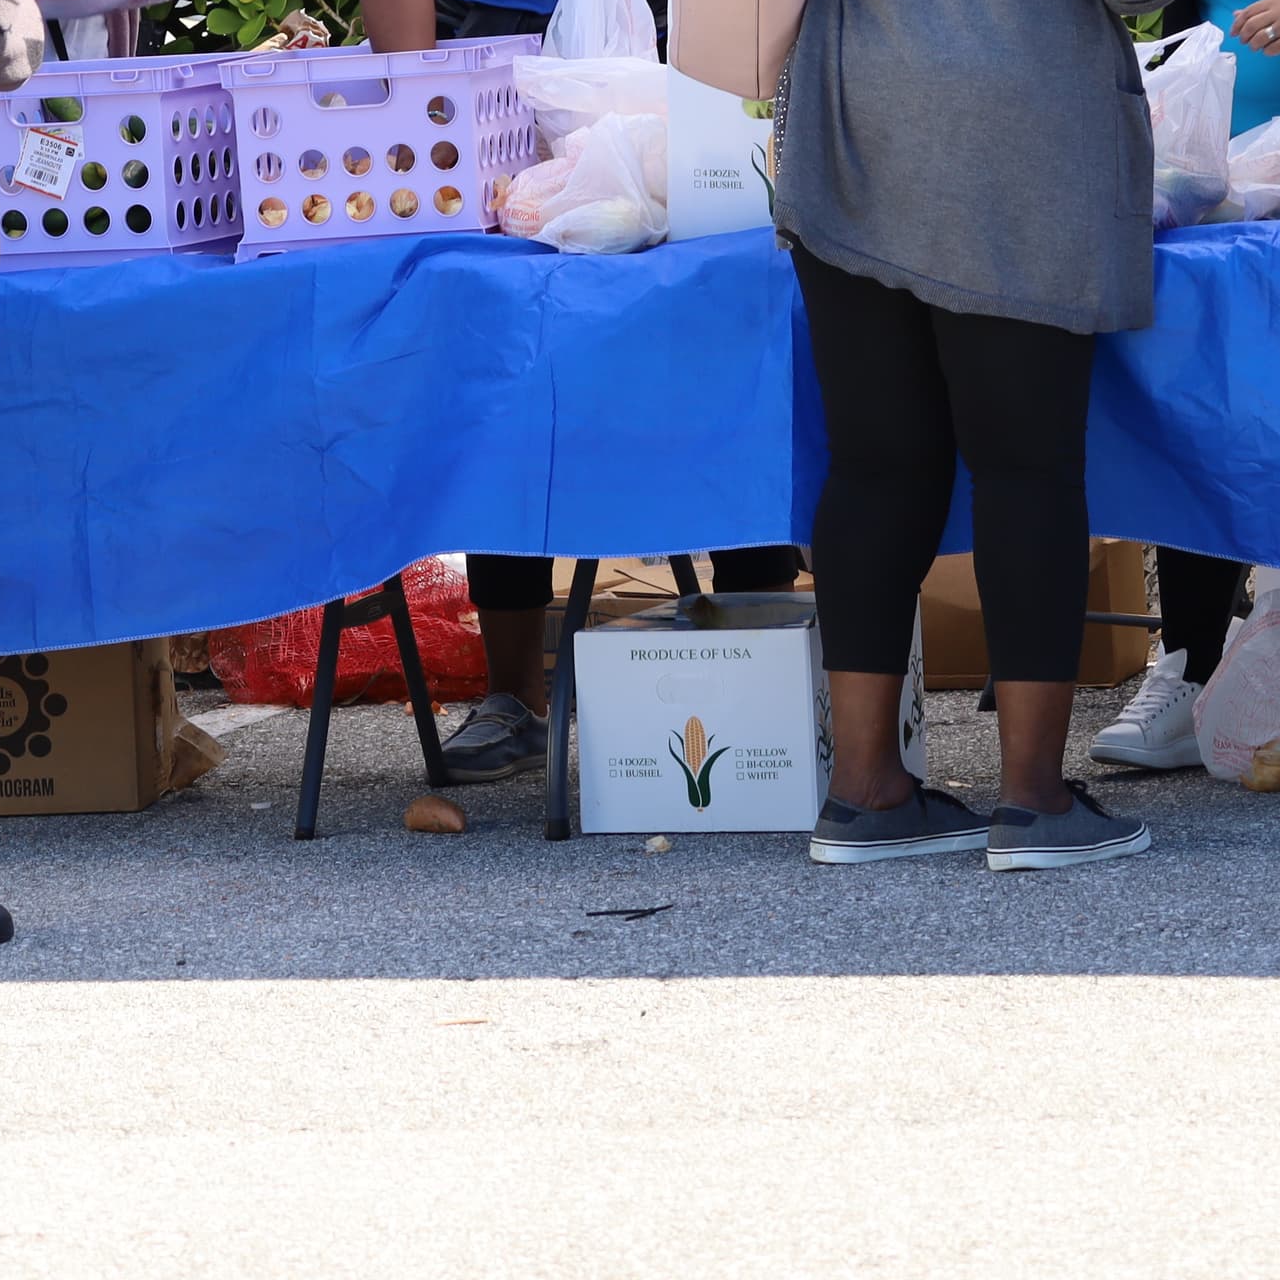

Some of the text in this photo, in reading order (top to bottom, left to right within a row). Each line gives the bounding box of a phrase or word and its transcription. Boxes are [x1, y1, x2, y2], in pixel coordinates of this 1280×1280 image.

[709, 169, 740, 178] DOZEN
[709, 180, 745, 190] BUSHEL
[630, 646, 753, 662] PRODUCE OF USA
[746, 748, 788, 757] YELLOW
[625, 757, 657, 766] DOZEN
[746, 759, 793, 769] BI-COLOR
[625, 769, 663, 778] BUSHEL
[747, 771, 779, 781] WHITE
